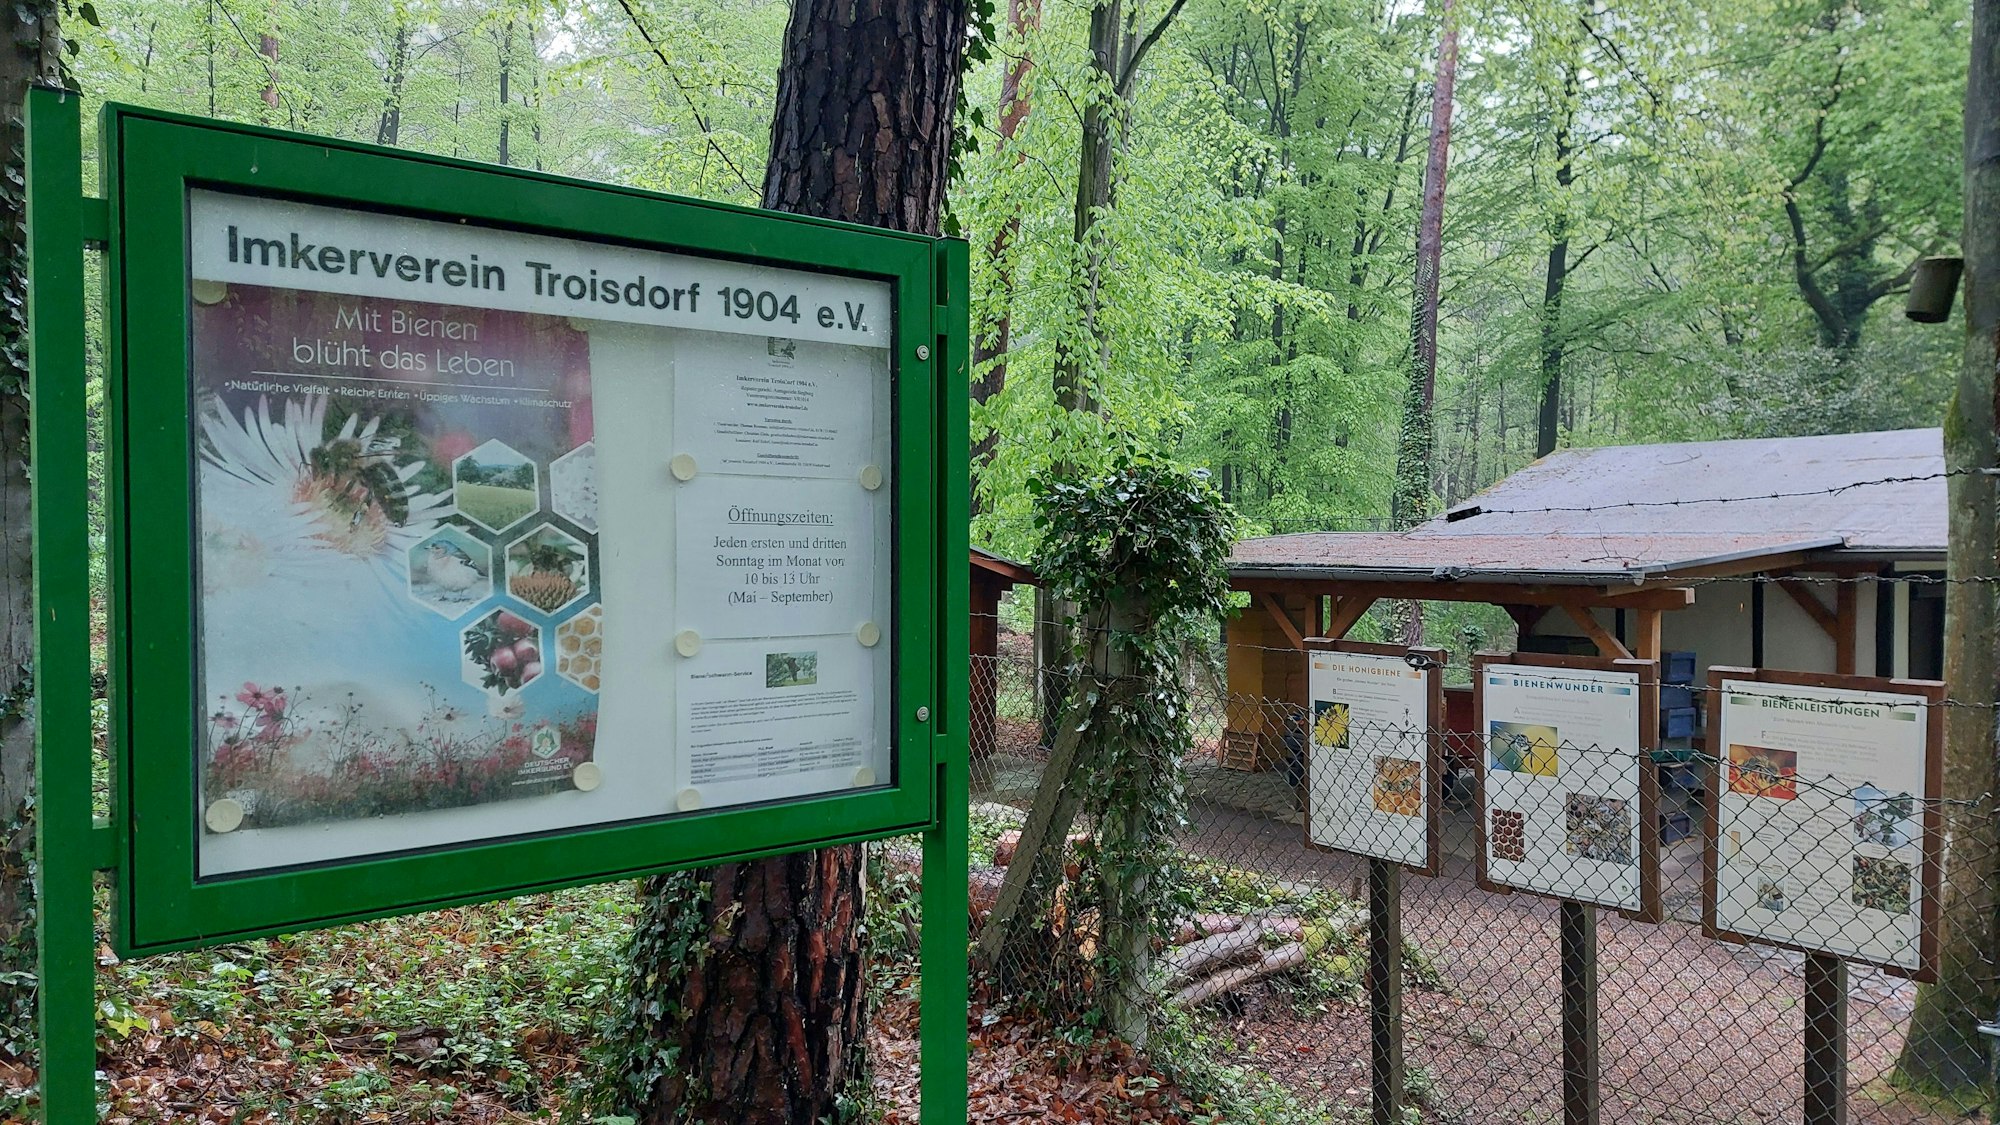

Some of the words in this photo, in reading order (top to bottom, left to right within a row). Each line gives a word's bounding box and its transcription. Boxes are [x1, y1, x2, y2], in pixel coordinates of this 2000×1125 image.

[228, 225, 505, 291] Imkerverein
[525, 261, 700, 313] Troisdorf
[718, 286, 801, 324] 1904
[817, 301, 868, 332] e.V.
[335, 305, 382, 333] Mit
[391, 310, 478, 341] Bienen
[293, 337, 371, 368] blüht
[380, 343, 427, 372] das
[436, 348, 515, 378] Leben
[231, 380, 290, 393] Natürliche
[293, 383, 330, 395] Vielfalt
[341, 386, 375, 398] Reiche
[378, 388, 410, 400] Ernten
[419, 389, 459, 404] Üppiges
[460, 394, 510, 405] Wachstum
[519, 397, 572, 409] Klimaschutz
[727, 505, 834, 527] Öffnungszeiten:
[713, 536, 747, 549] Jeden
[751, 538, 785, 549] ersten
[789, 537, 809, 549] und
[812, 537, 847, 549] dritten
[716, 555, 764, 569] Sonntag
[768, 555, 782, 567] im
[786, 555, 821, 567] Monat
[825, 557, 846, 567] von
[745, 573, 759, 585] 10
[762, 572, 779, 585] bis
[782, 573, 795, 585] 13
[799, 572, 821, 585] Uhr
[728, 591, 757, 606] (Mai
[771, 590, 834, 605] September)
[1332, 664, 1345, 672] DIE
[1349, 665, 1401, 678] HONIGBIENE
[1513, 679, 1604, 694] BIENENWUNDER
[1762, 699, 1880, 718] BIENENLEISTUNGEN
[524, 757, 570, 769] DEUTSCHER
